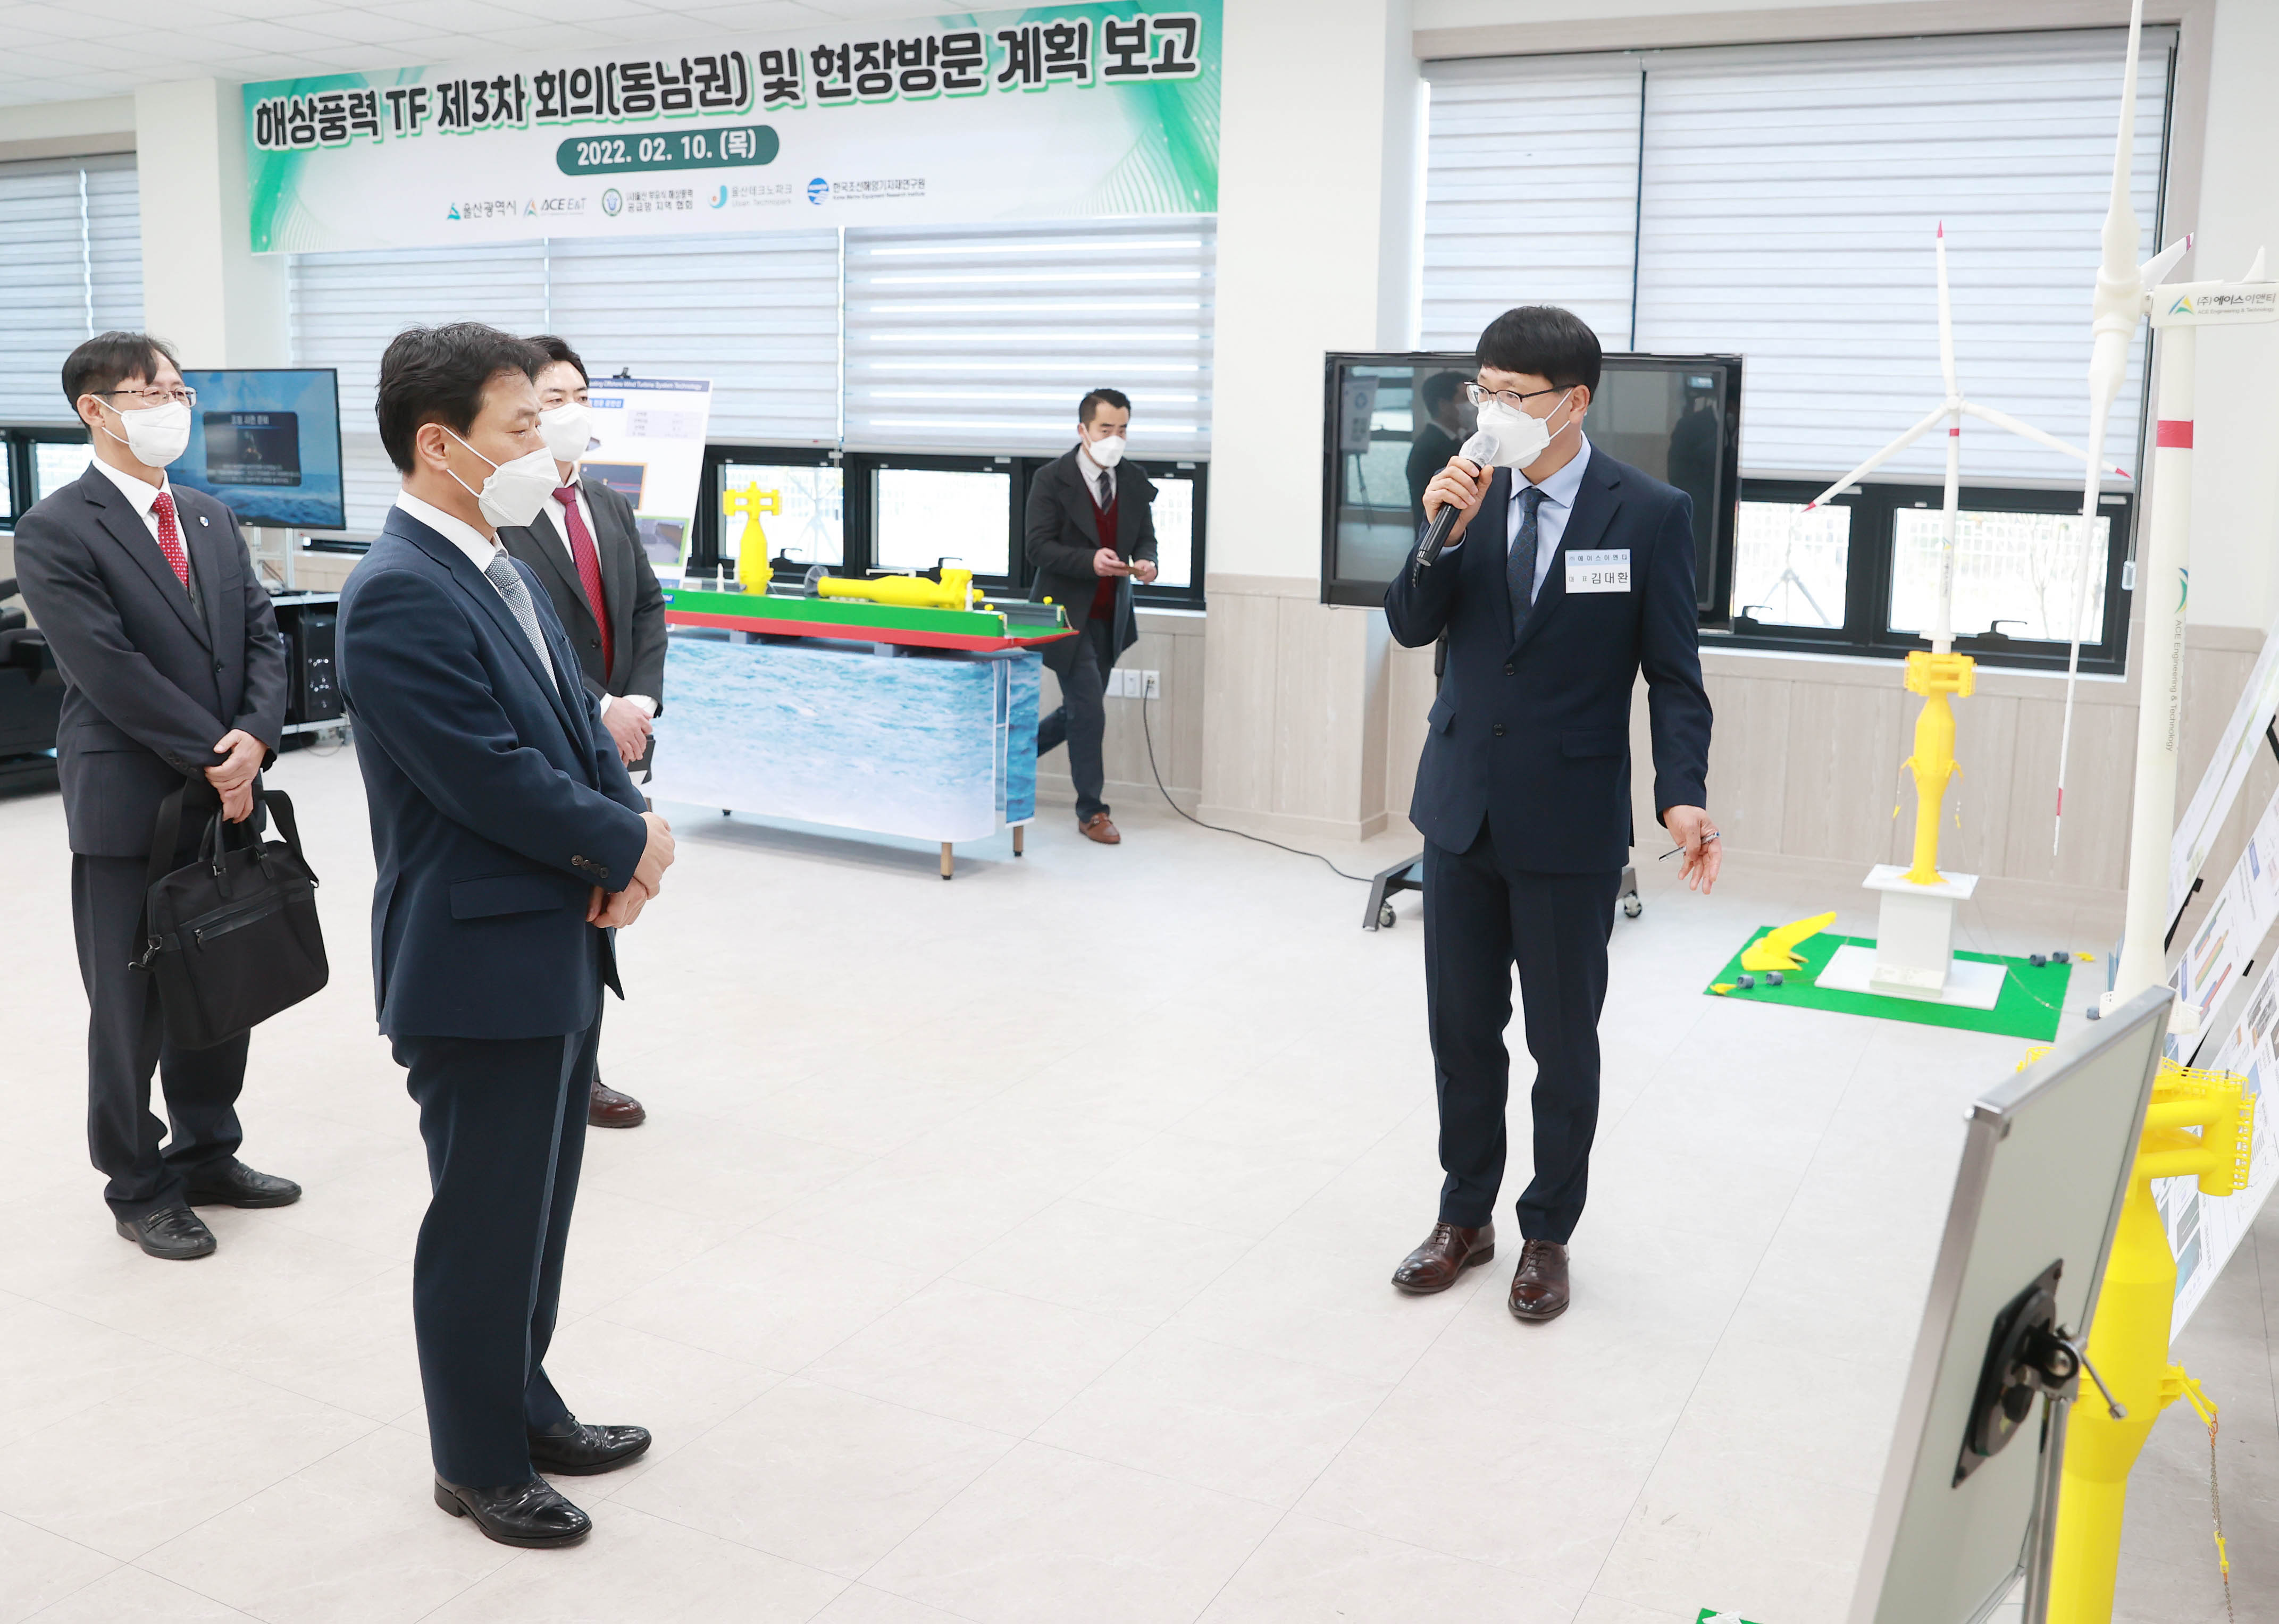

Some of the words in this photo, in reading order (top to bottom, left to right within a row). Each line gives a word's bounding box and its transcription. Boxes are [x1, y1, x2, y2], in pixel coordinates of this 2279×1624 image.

[257, 90, 377, 146] 해상풍력
[386, 88, 428, 131] TF
[437, 73, 525, 128] 제3차
[534, 51, 747, 117] 회의(동남권)
[759, 48, 800, 102] 및
[810, 32, 983, 98] 현장방문
[998, 22, 1088, 83] 계획
[1104, 18, 1196, 75] 보고
[577, 141, 632, 166] 2022.
[639, 138, 672, 162] 02.
[681, 135, 713, 159] 10.
[719, 129, 756, 159] (목)
[541, 198, 565, 211] ACE
[732, 184, 792, 197] 울산테크노파크
[463, 200, 516, 219] 울산광역시
[1591, 571, 1629, 584] 김대환
[2169, 642, 2181, 693] Engineering
[2166, 704, 2177, 752] Technology
